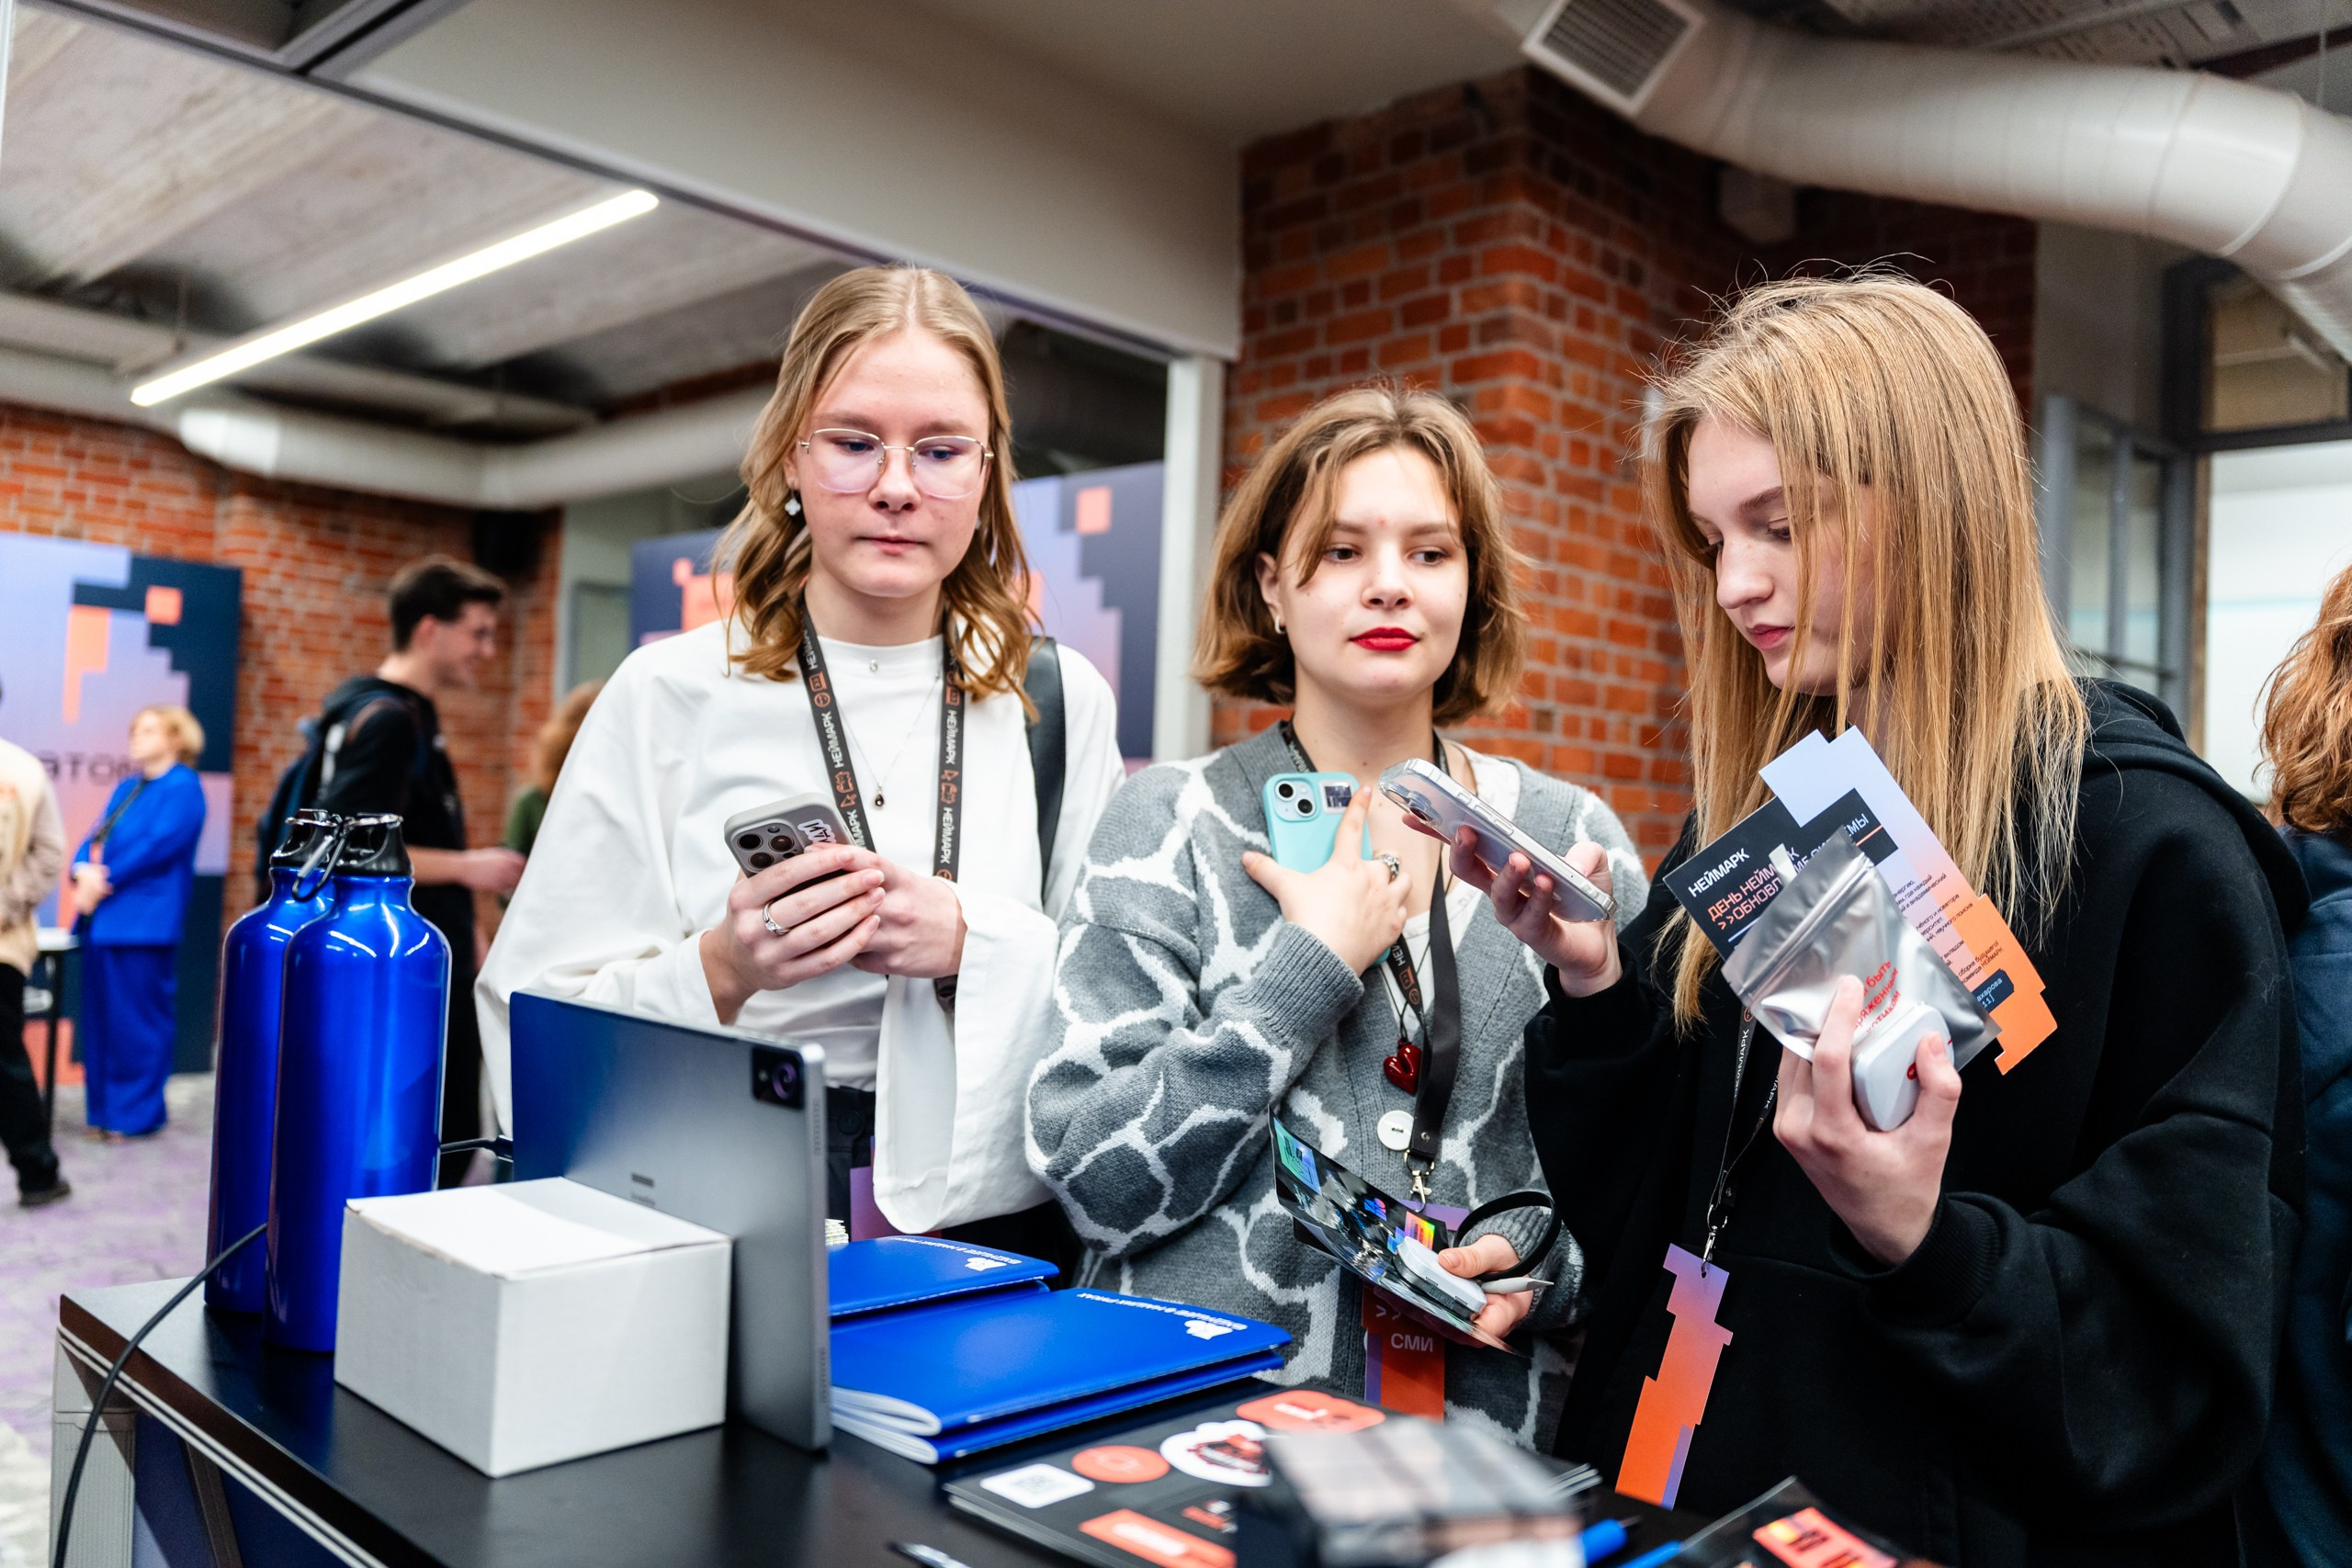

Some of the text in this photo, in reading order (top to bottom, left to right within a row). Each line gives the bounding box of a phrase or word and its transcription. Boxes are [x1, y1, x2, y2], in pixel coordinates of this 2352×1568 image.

[822, 710, 844, 769] НЕЙМАРК
[944, 709, 958, 765] НЕЙМАРК
[939, 807, 953, 865] НЕЙМАРК
[1688, 847, 1749, 897] НЕЙМАРК
[1706, 846, 1798, 921] ДЕНЬ НЕЙМК
[1913, 874, 1932, 892] каждый
[1908, 873, 1947, 905] академический
[1937, 894, 1959, 913] новатора
[1955, 902, 1973, 918] поиска
[1943, 940, 1964, 958] вкладом
[1980, 946, 2003, 967] НЕЙМАРК
[1865, 959, 1892, 988] быть
[1734, 1028, 1748, 1098] НЕЙМАРК
[1390, 1333, 1434, 1353] СМИ
